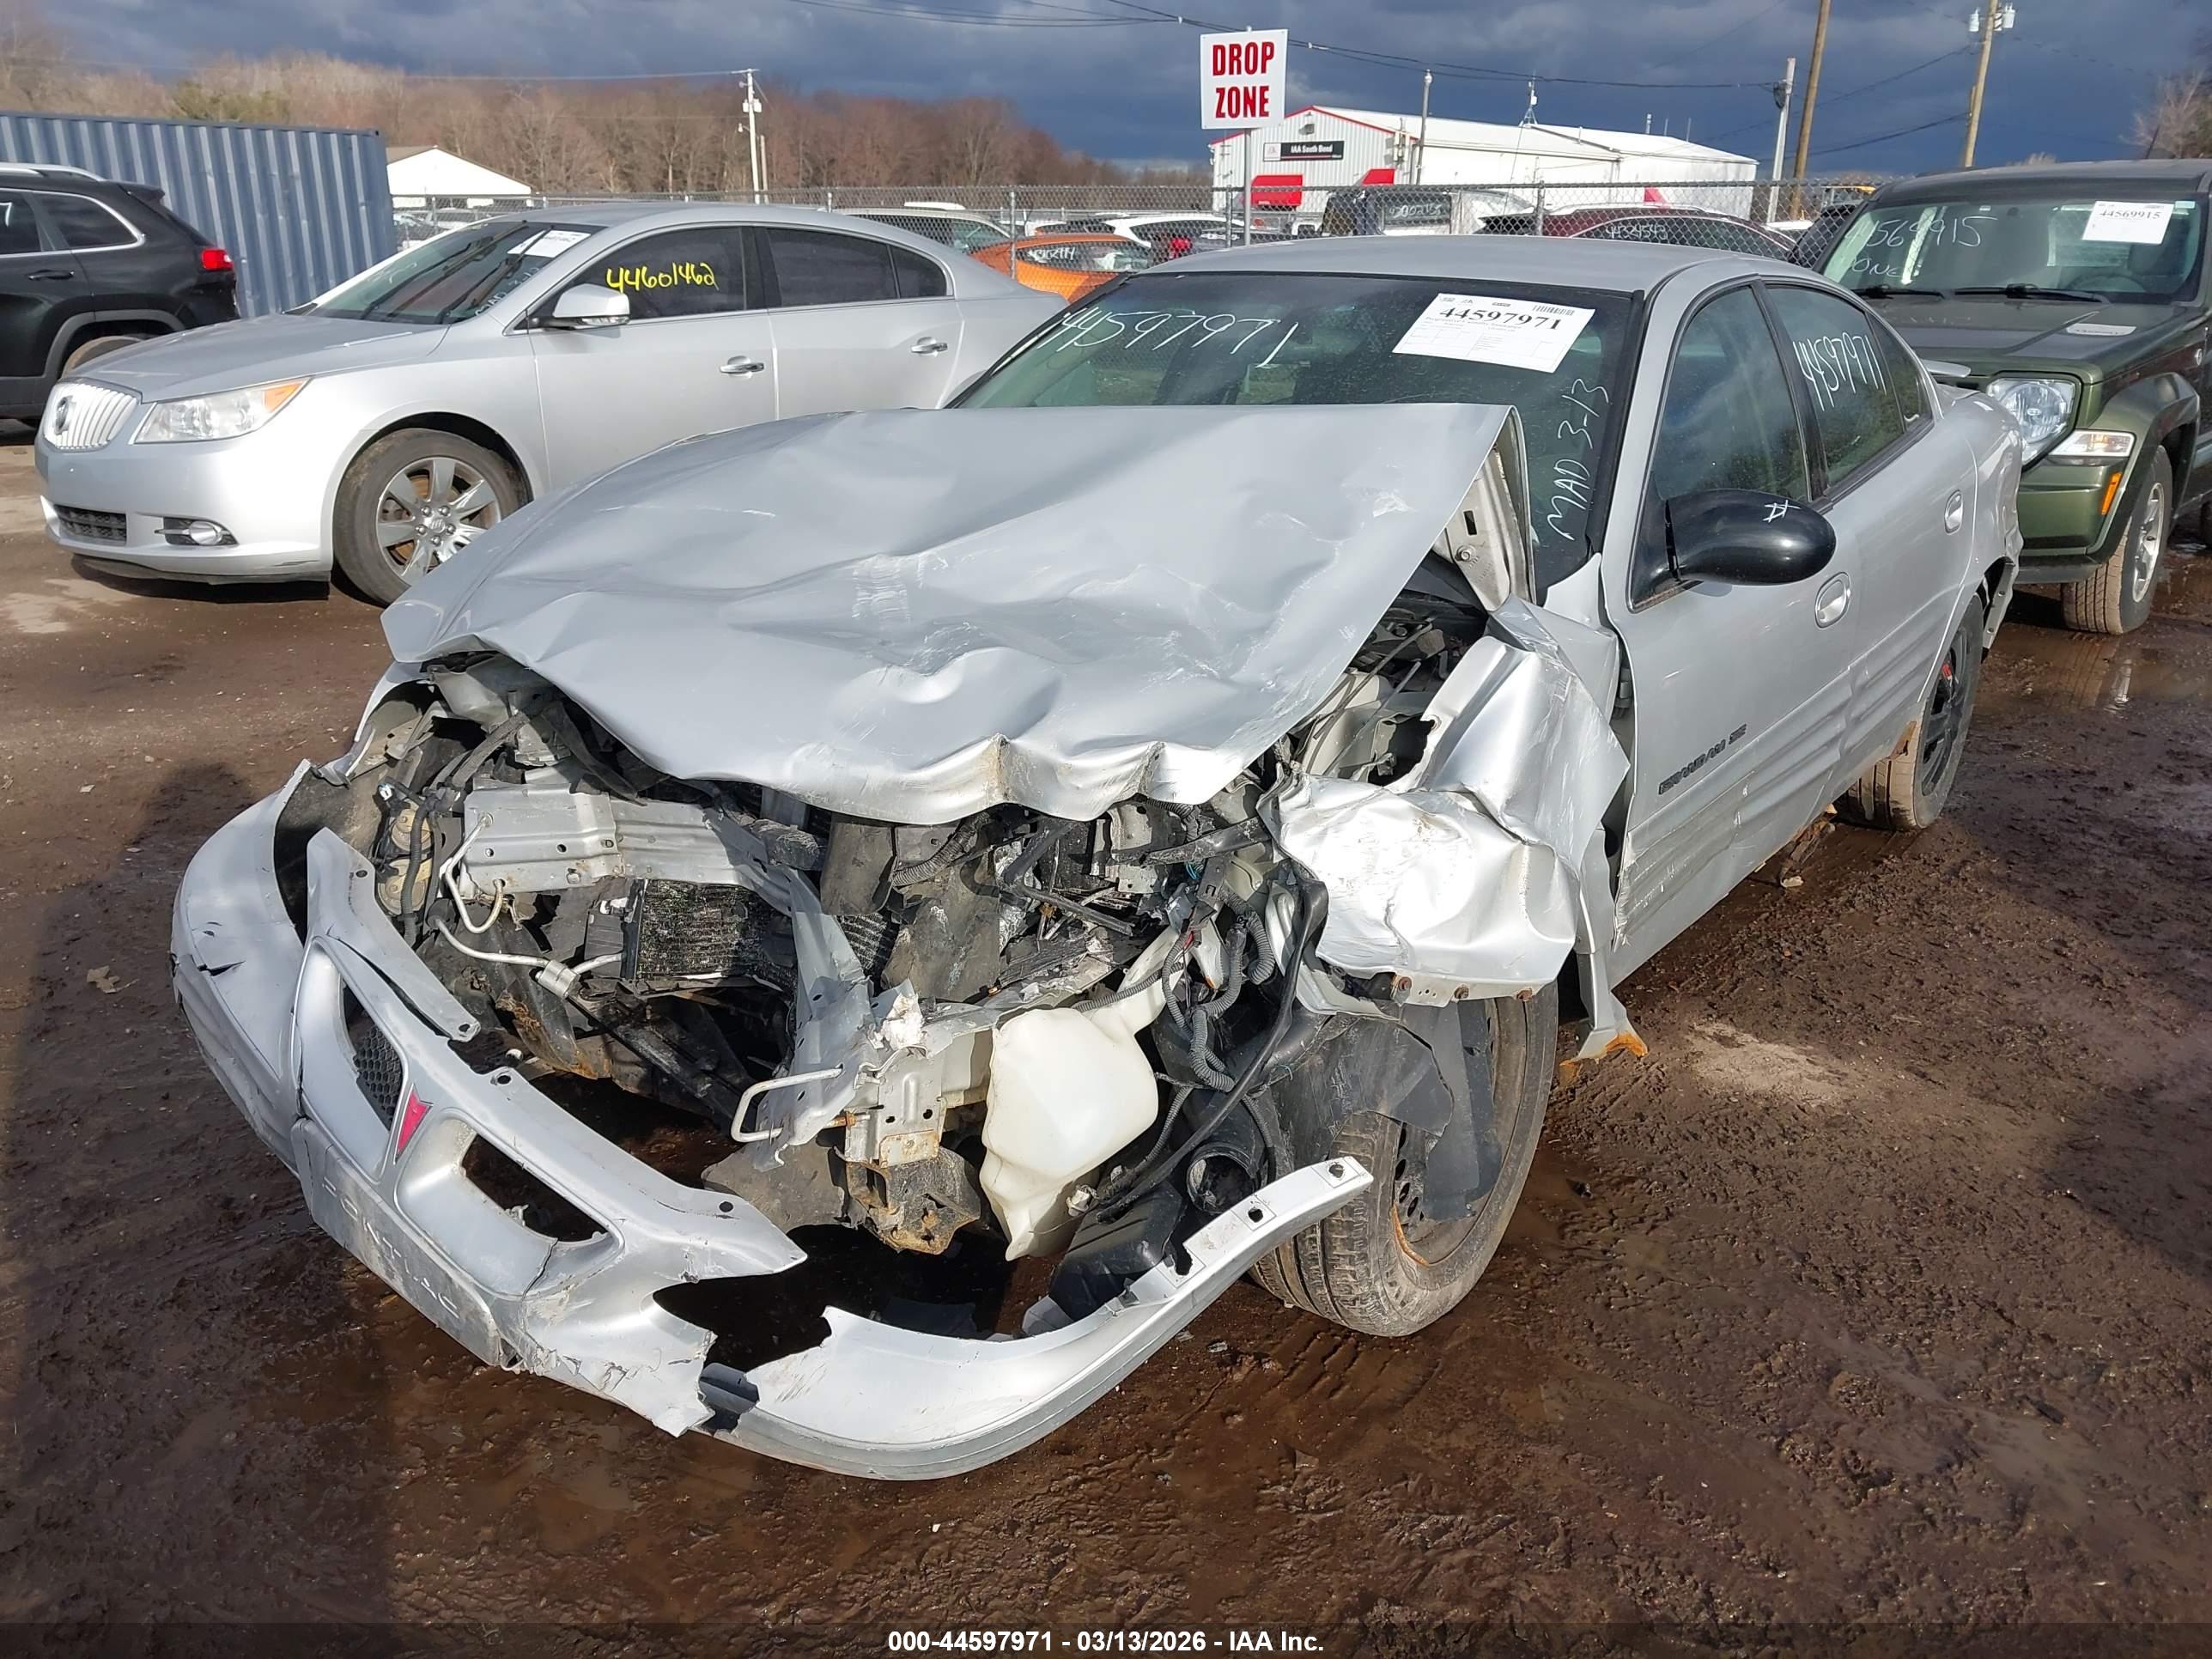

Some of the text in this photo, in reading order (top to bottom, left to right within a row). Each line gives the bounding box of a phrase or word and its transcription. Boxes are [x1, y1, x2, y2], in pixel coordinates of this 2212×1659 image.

[1212, 41, 1275, 76] DROP
[1215, 85, 1270, 118] ZONE
[2100, 209, 2162, 219] 44569915
[606, 262, 719, 294] 44601462
[1439, 307, 1562, 331] 44597971
[1036, 306, 1299, 368] 44597971
[1792, 331, 1887, 412] 44597971
[1547, 378, 1610, 541] MAD 3-13
